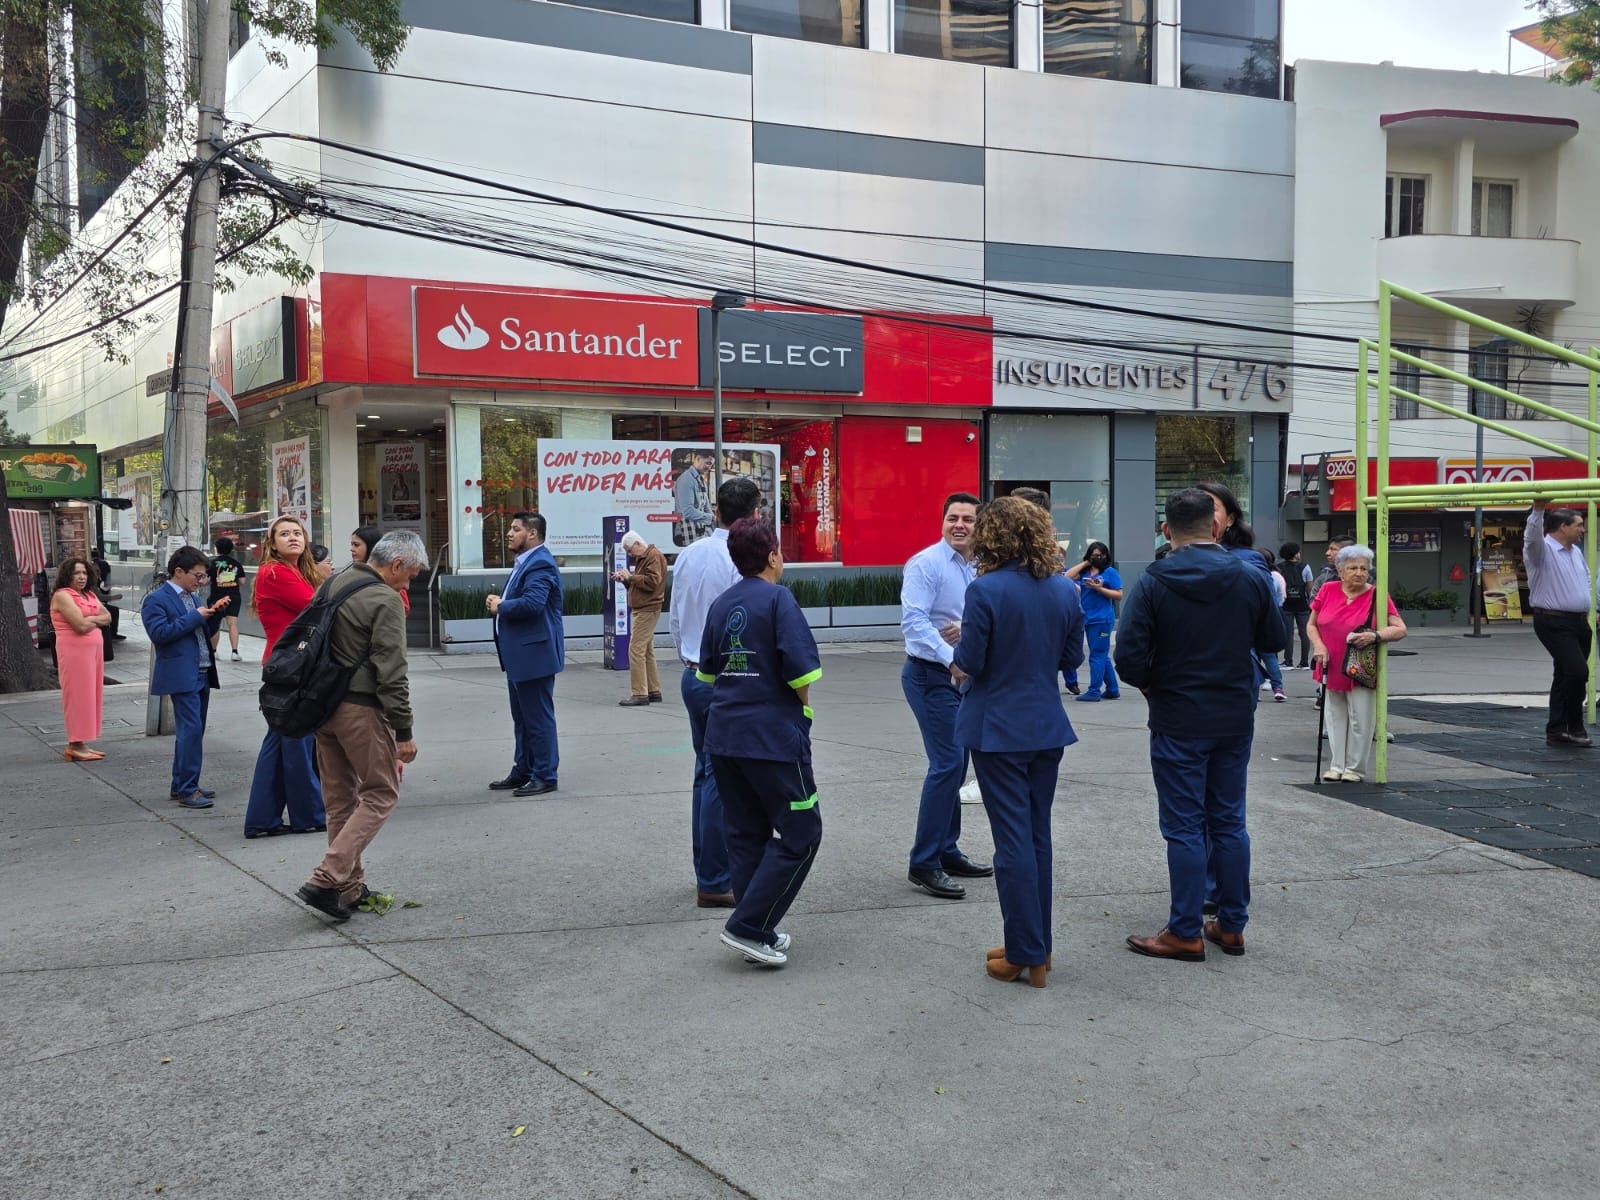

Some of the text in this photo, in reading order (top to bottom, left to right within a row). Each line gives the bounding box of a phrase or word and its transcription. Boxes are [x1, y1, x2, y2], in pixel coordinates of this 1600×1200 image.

[500, 317, 682, 360] Santander
[719, 341, 852, 367] SELECT
[996, 358, 1288, 401] INSURGENTES 476
[385, 447, 397, 455] CON
[385, 454, 403, 463] PARA
[543, 448, 672, 468] CON TODO PARA
[381, 463, 419, 475] NEGOCIO
[1326, 460, 1356, 477] OXXO
[546, 467, 680, 494] VENDER MÁS
